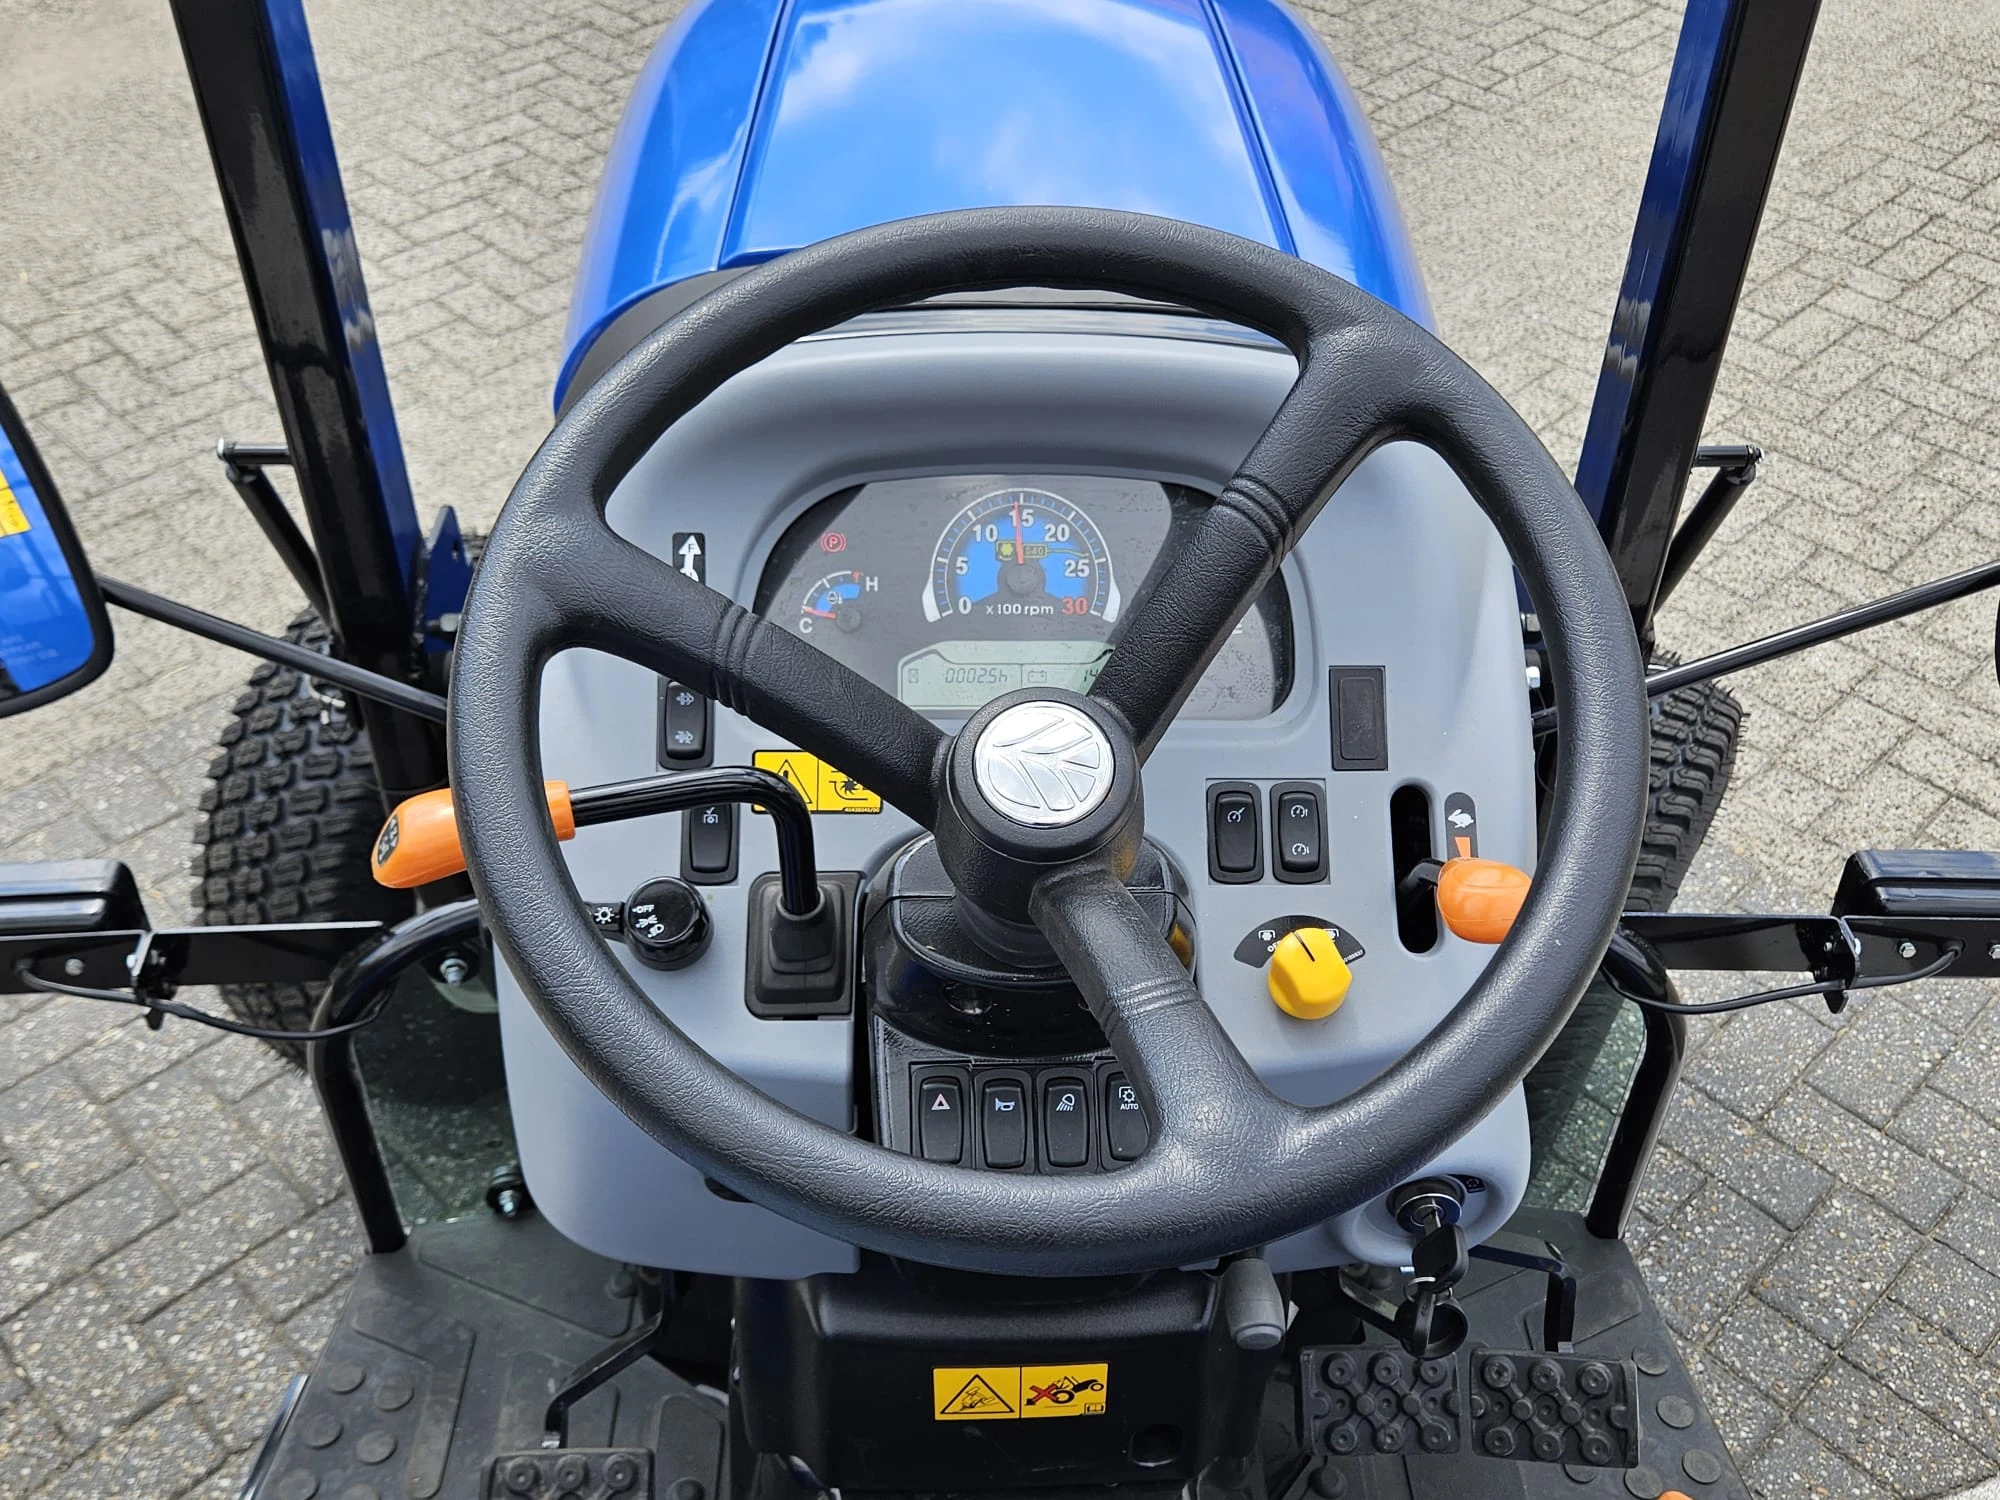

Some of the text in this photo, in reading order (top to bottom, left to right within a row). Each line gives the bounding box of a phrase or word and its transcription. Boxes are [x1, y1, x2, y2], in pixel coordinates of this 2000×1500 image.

[1009, 509, 1034, 527] 15
[973, 524, 998, 542] 10
[1044, 524, 1070, 542] 20
[688, 543, 696, 553] F
[829, 536, 838, 548] P
[955, 557, 968, 575] 5
[1064, 559, 1090, 577] 25
[866, 576, 878, 592] H
[958, 597, 972, 615] 0
[1024, 604, 1054, 616] rpm
[1062, 597, 1088, 616] 30
[799, 617, 813, 634] C
[636, 904, 655, 914] OFF
[1120, 1102, 1139, 1111] AUTO
